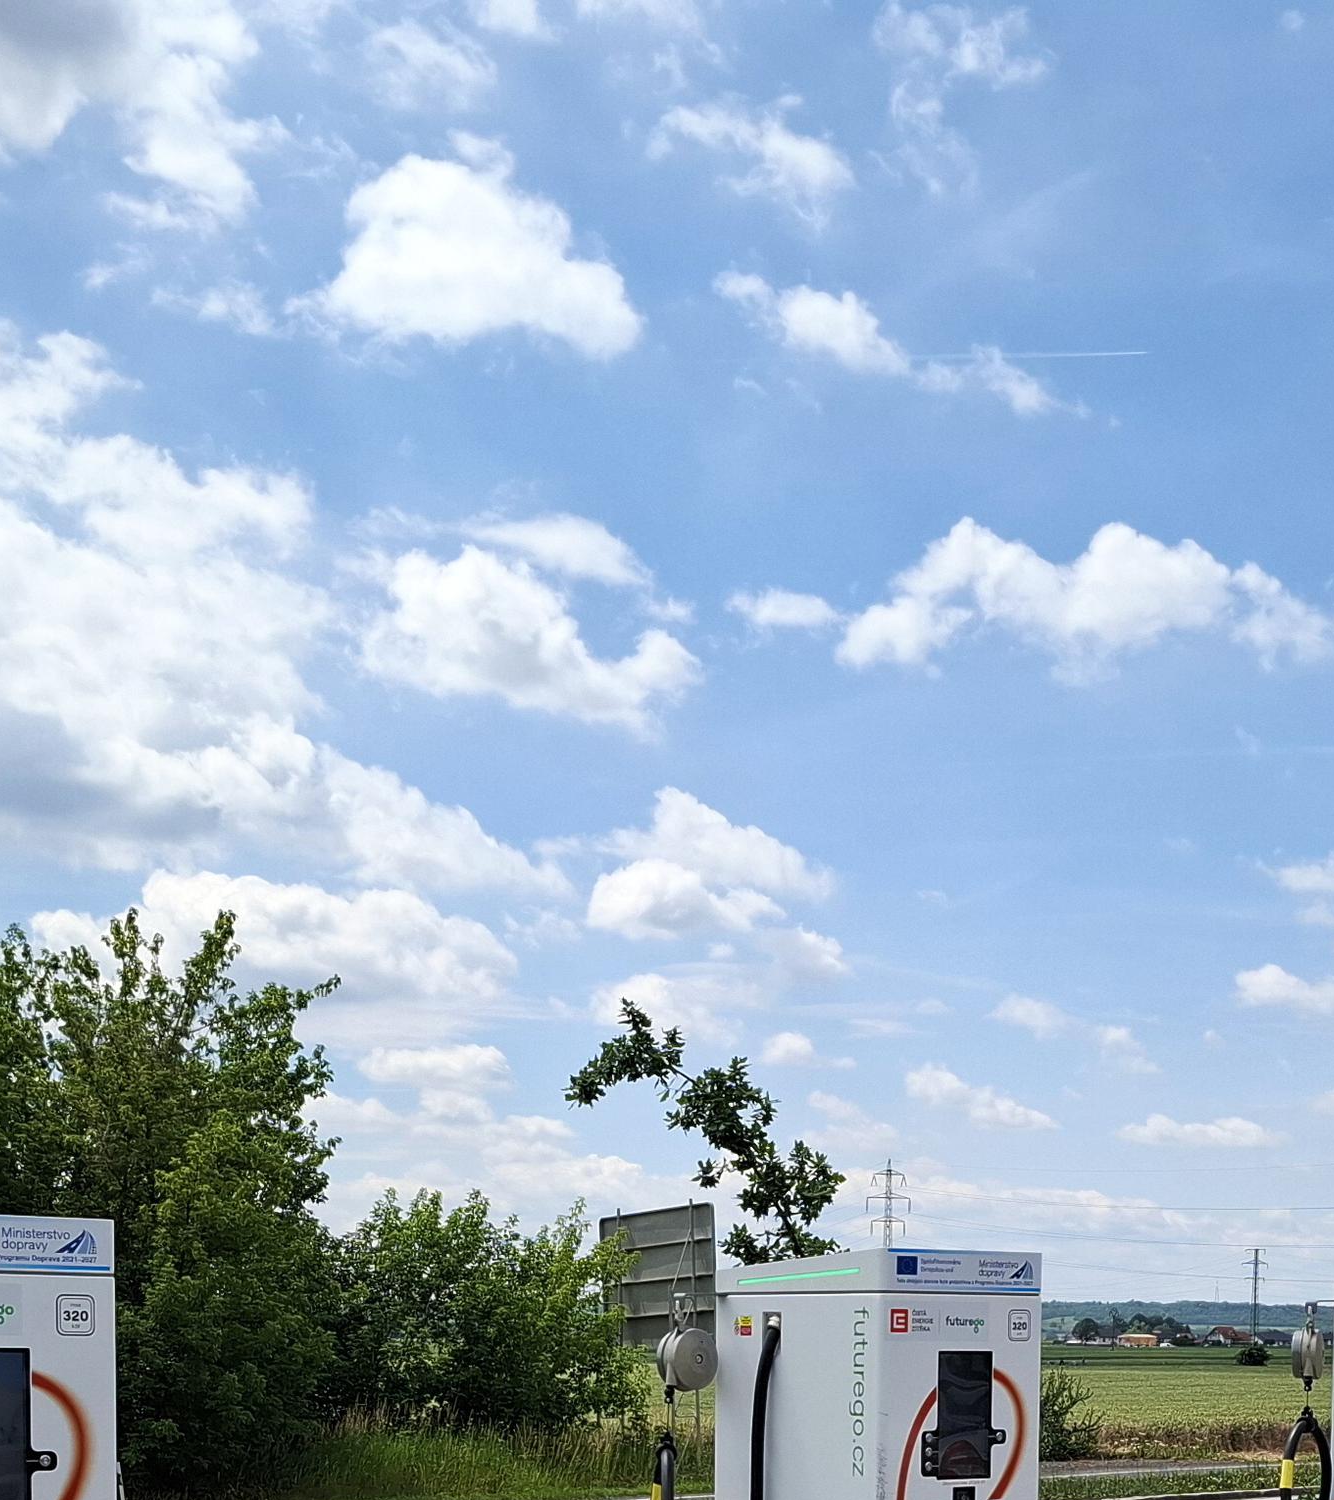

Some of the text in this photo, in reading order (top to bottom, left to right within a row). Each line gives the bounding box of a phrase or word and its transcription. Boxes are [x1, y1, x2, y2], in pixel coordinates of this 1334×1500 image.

[1, 1226, 71, 1241] Ministerstvo
[1, 1240, 49, 1253] dopravy
[63, 1310, 89, 1322] 320
[849, 1306, 870, 1477] futurego.cz
